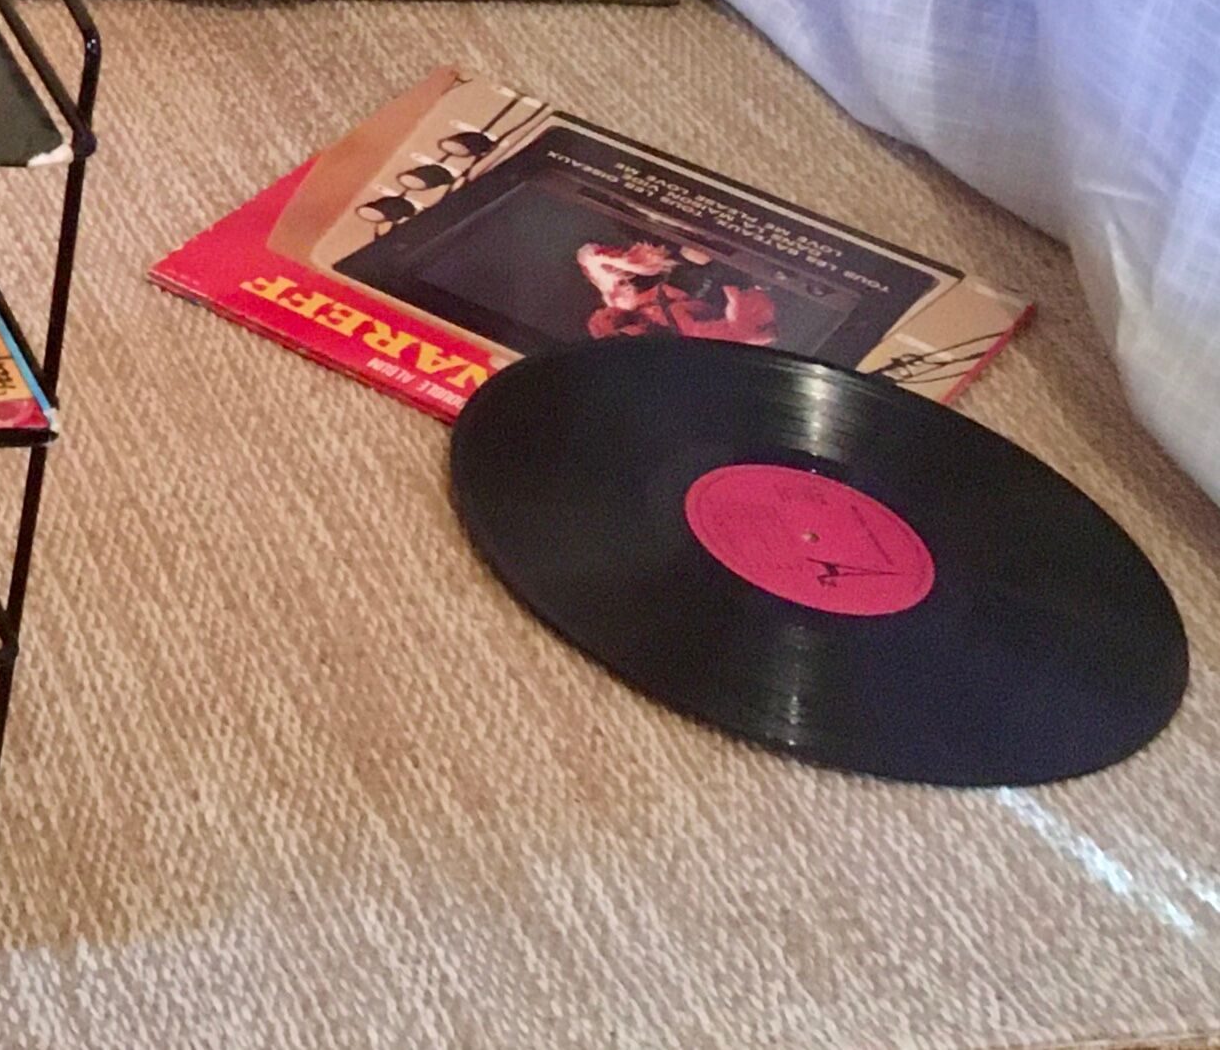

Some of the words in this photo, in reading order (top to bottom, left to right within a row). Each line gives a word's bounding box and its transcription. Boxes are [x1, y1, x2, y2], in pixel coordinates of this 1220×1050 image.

[546, 150, 618, 183] OISEAUX
[614, 162, 640, 176] ME
[622, 172, 659, 191] VIDE
[624, 180, 654, 198] LES
[646, 174, 689, 196] LOVE
[659, 196, 703, 218] TOUS
[667, 191, 734, 221] MAISON
[695, 195, 758, 223] PLEASE
[739, 219, 765, 234] LA
[764, 222, 790, 236] ME
[772, 234, 822, 257] DANS
[796, 235, 843, 257] LOVE
[805, 254, 837, 270] LES
[843, 269, 889, 294] TOUS
[367, 357, 416, 383] ALBUM
